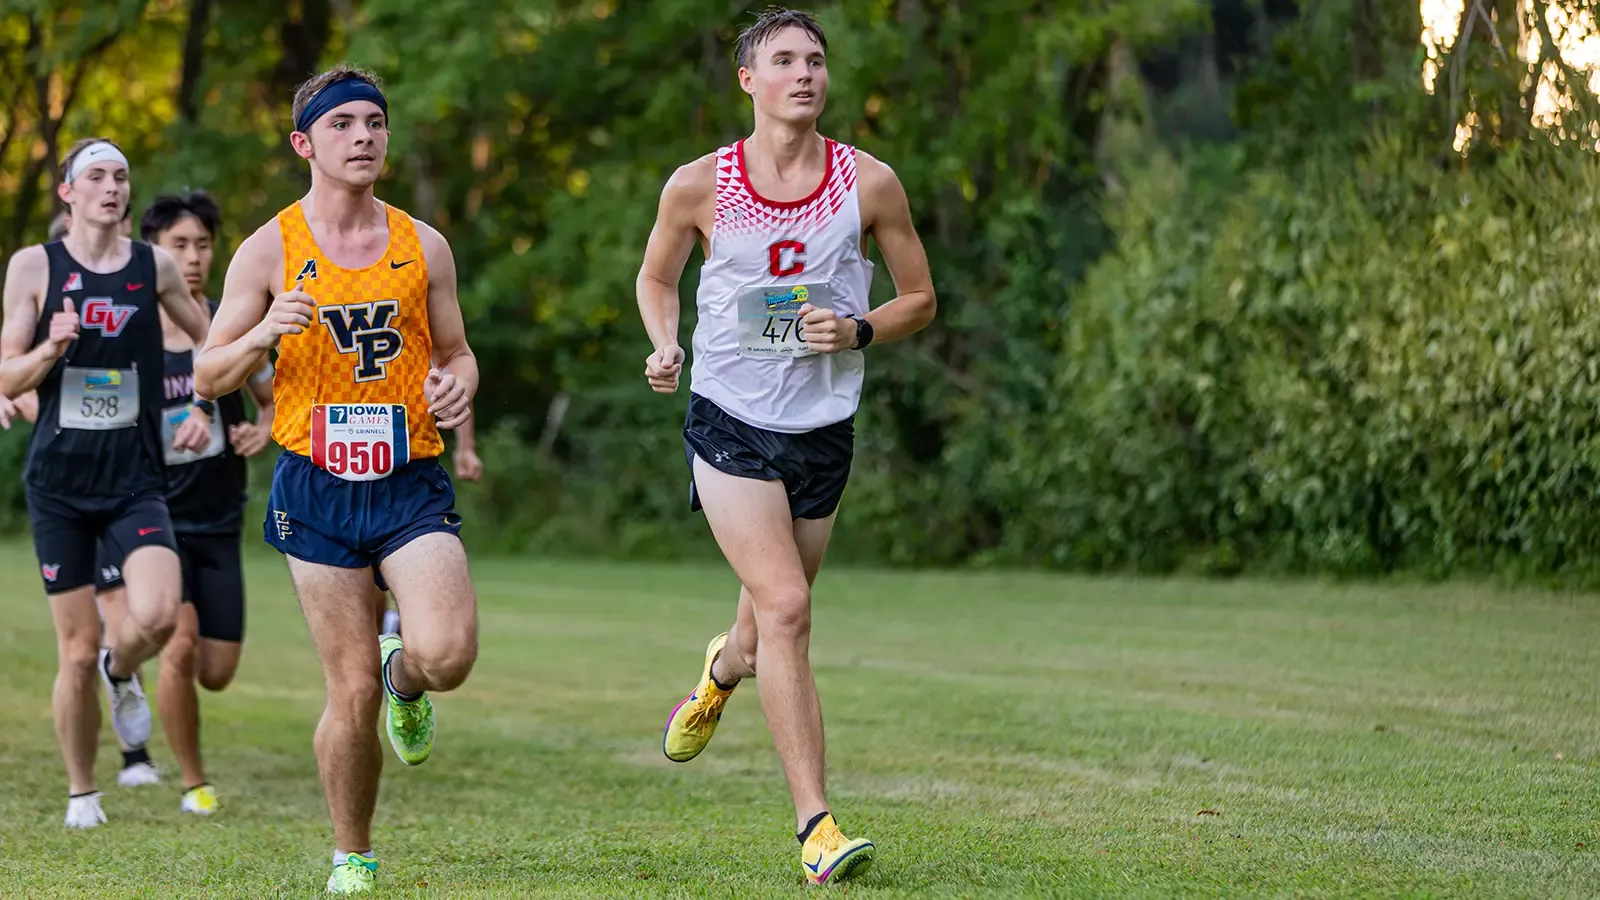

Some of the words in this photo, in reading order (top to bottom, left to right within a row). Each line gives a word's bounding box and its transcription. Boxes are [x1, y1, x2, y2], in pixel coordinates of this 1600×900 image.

[767, 239, 807, 277] C
[81, 296, 139, 337] GV
[317, 299, 404, 383] WP
[81, 396, 119, 418] 528
[348, 416, 390, 425] GAMES
[349, 406, 388, 416] IOWA
[328, 441, 391, 475] 950
